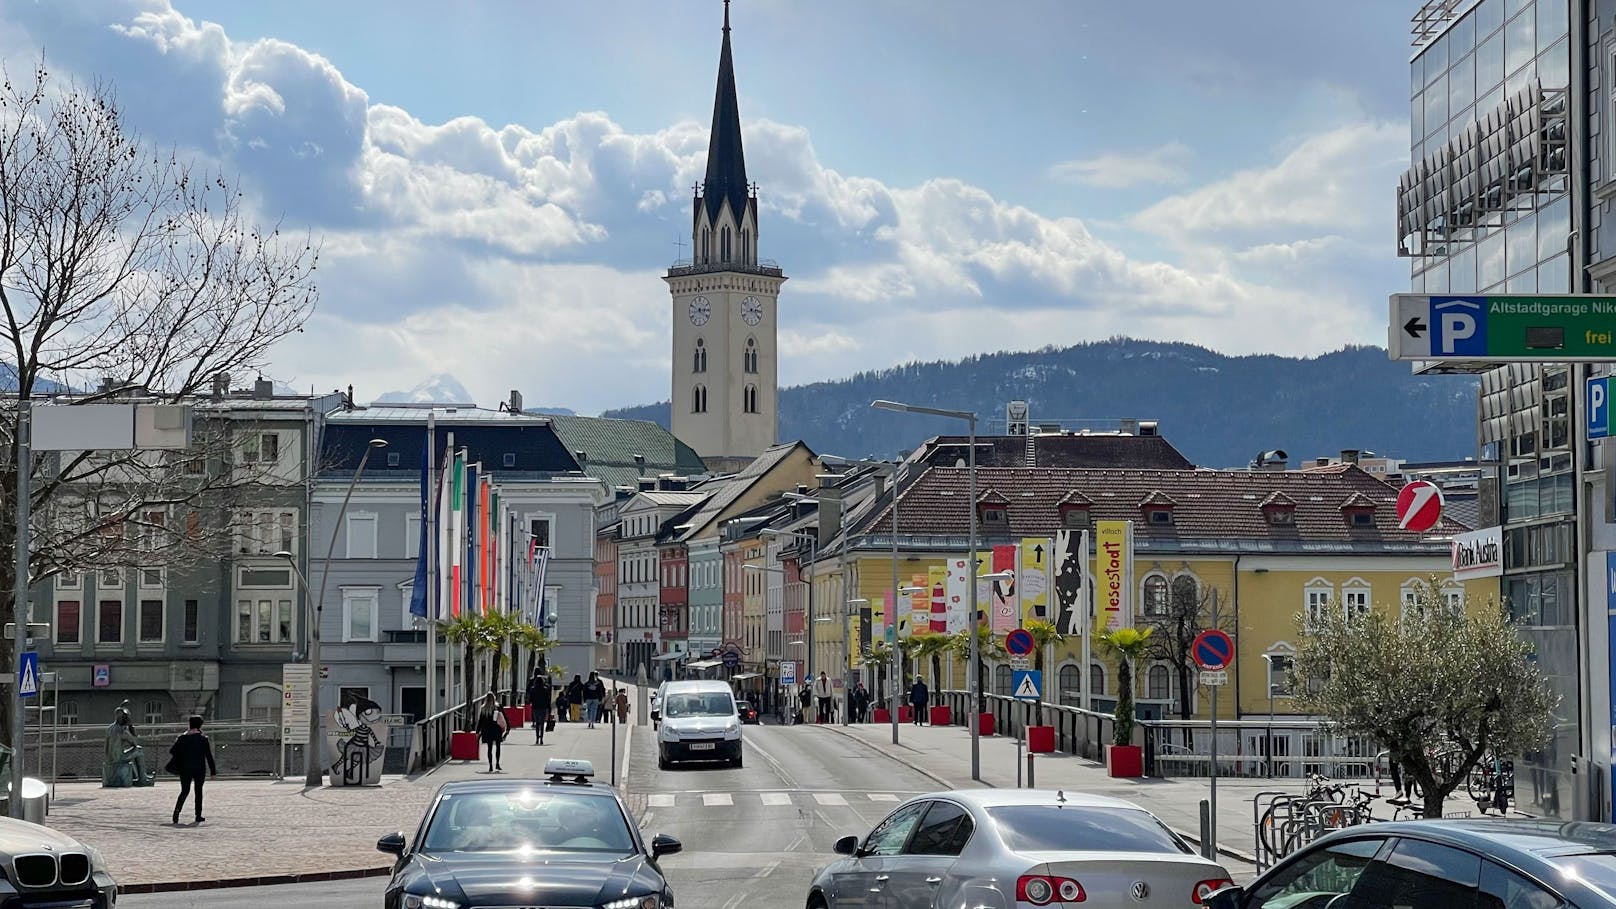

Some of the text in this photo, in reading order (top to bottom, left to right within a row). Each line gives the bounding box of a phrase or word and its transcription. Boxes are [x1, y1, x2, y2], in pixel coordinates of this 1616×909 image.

[1490, 302, 1616, 316] Altstadtgarage Nik
[1441, 312, 1477, 353] P
[1585, 330, 1612, 344] frei
[1591, 384, 1605, 423] P
[1458, 536, 1498, 567] Bank Austria
[1102, 541, 1121, 612] lesestadt
